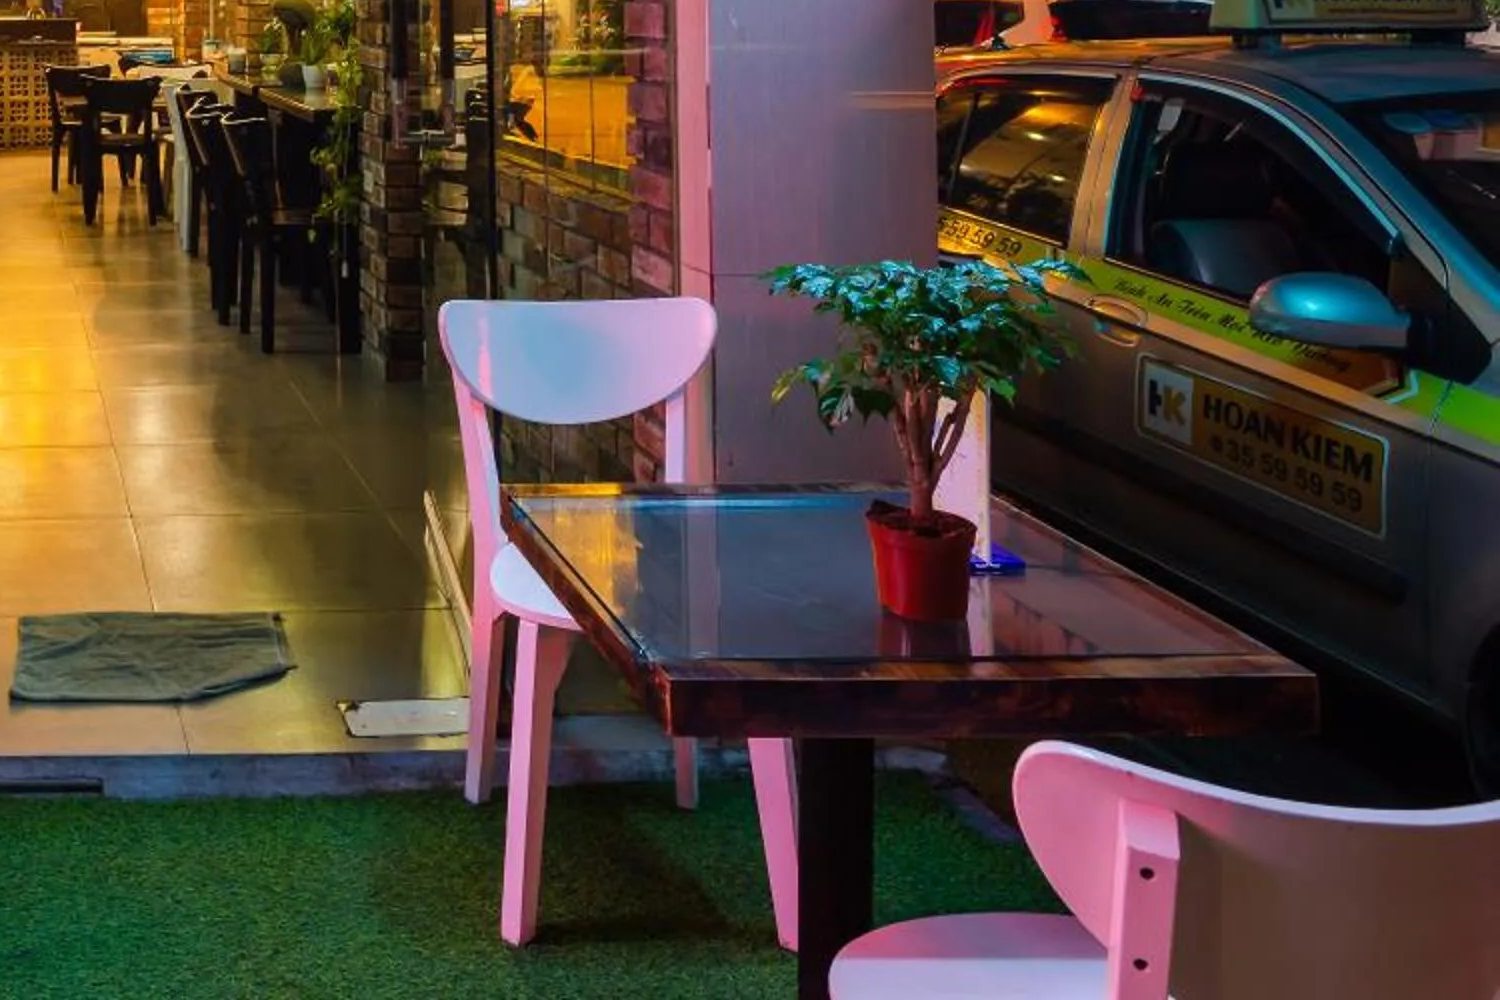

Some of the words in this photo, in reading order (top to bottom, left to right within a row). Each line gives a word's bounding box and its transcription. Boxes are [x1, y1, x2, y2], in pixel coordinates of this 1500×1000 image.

[996, 236, 1023, 257] 59
[1203, 393, 1286, 450] HOAN
[1292, 424, 1373, 484] KIEM
[1260, 452, 1288, 482] 59
[1293, 466, 1324, 498] 59
[1330, 480, 1363, 513] 59
